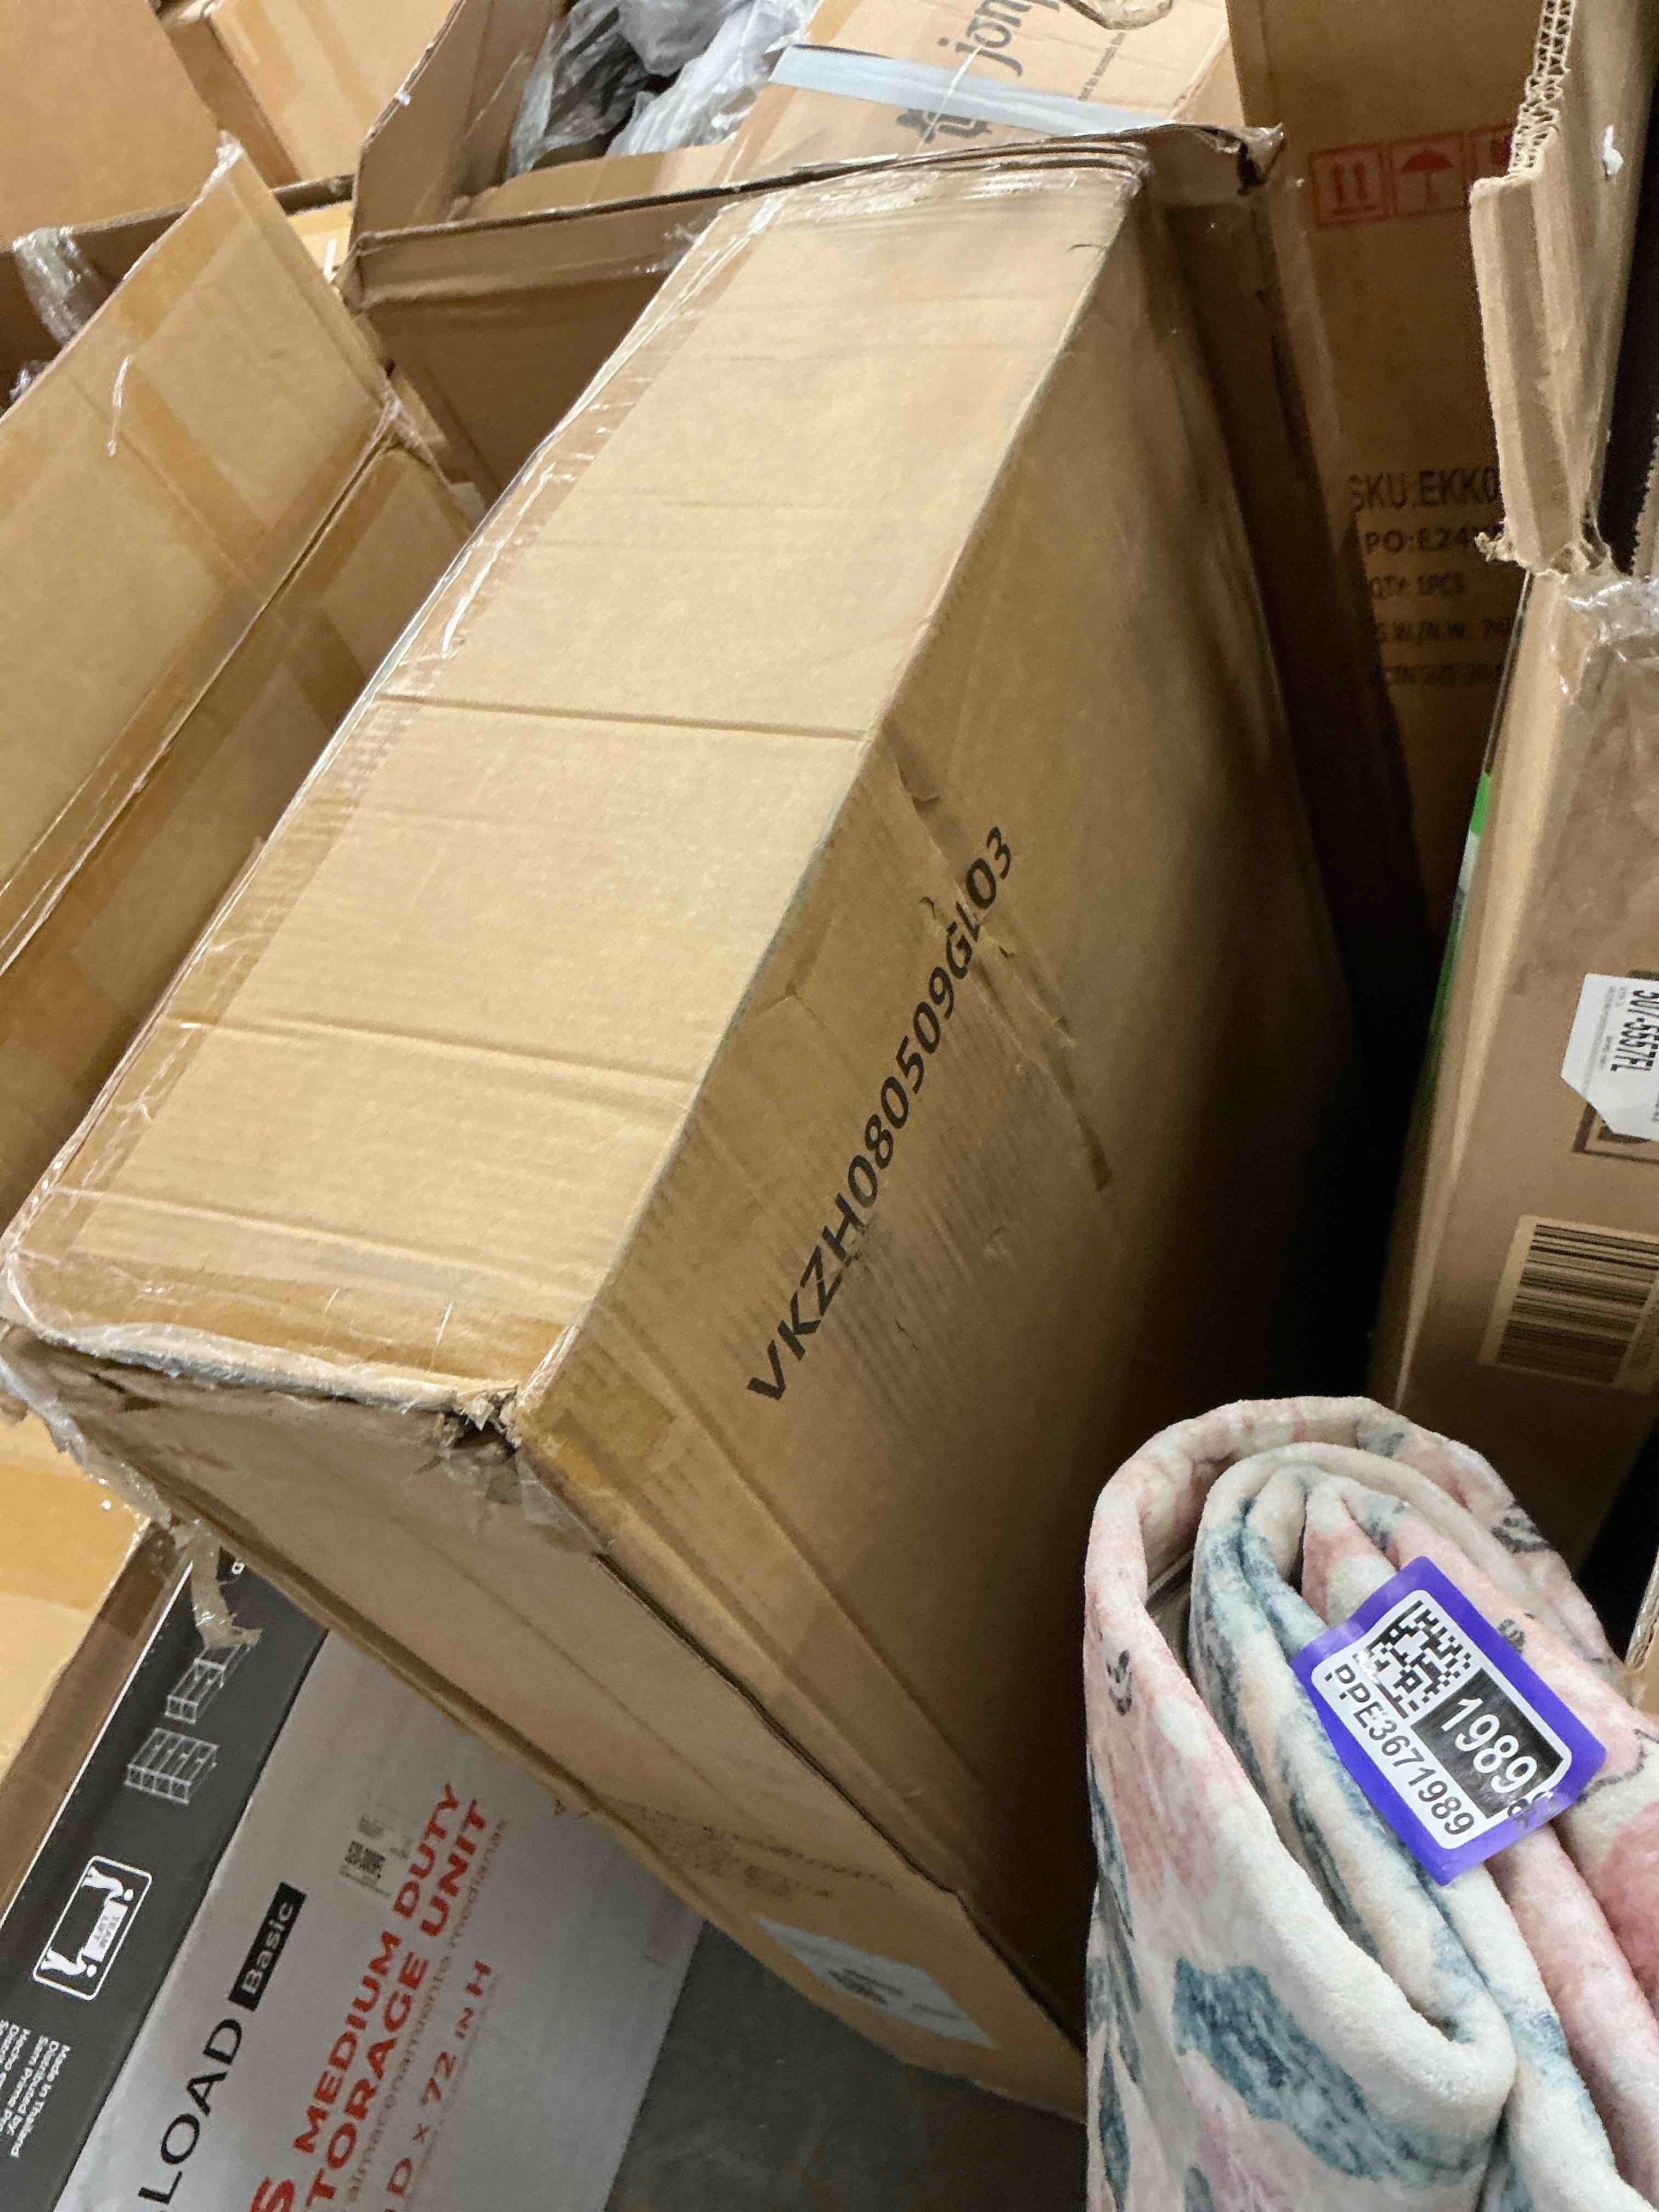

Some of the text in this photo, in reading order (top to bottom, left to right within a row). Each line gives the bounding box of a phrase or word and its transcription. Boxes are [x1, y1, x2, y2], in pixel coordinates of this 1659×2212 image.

[1324, 1663, 1475, 1836] PPE3671989
[1440, 1697, 1538, 1793] 1989
[241, 1900, 295, 1995] Basic
[292, 1931, 403, 2154] MEDIUM
[393, 1782, 459, 1919] DUTY
[306, 1951, 429, 2207] TORAGE
[420, 1799, 486, 1937] UNIT
[138, 2018, 242, 2204] LOAD
[387, 2158, 413, 2196] D
[420, 2051, 457, 2106] 72
[465, 1960, 493, 1996] H
